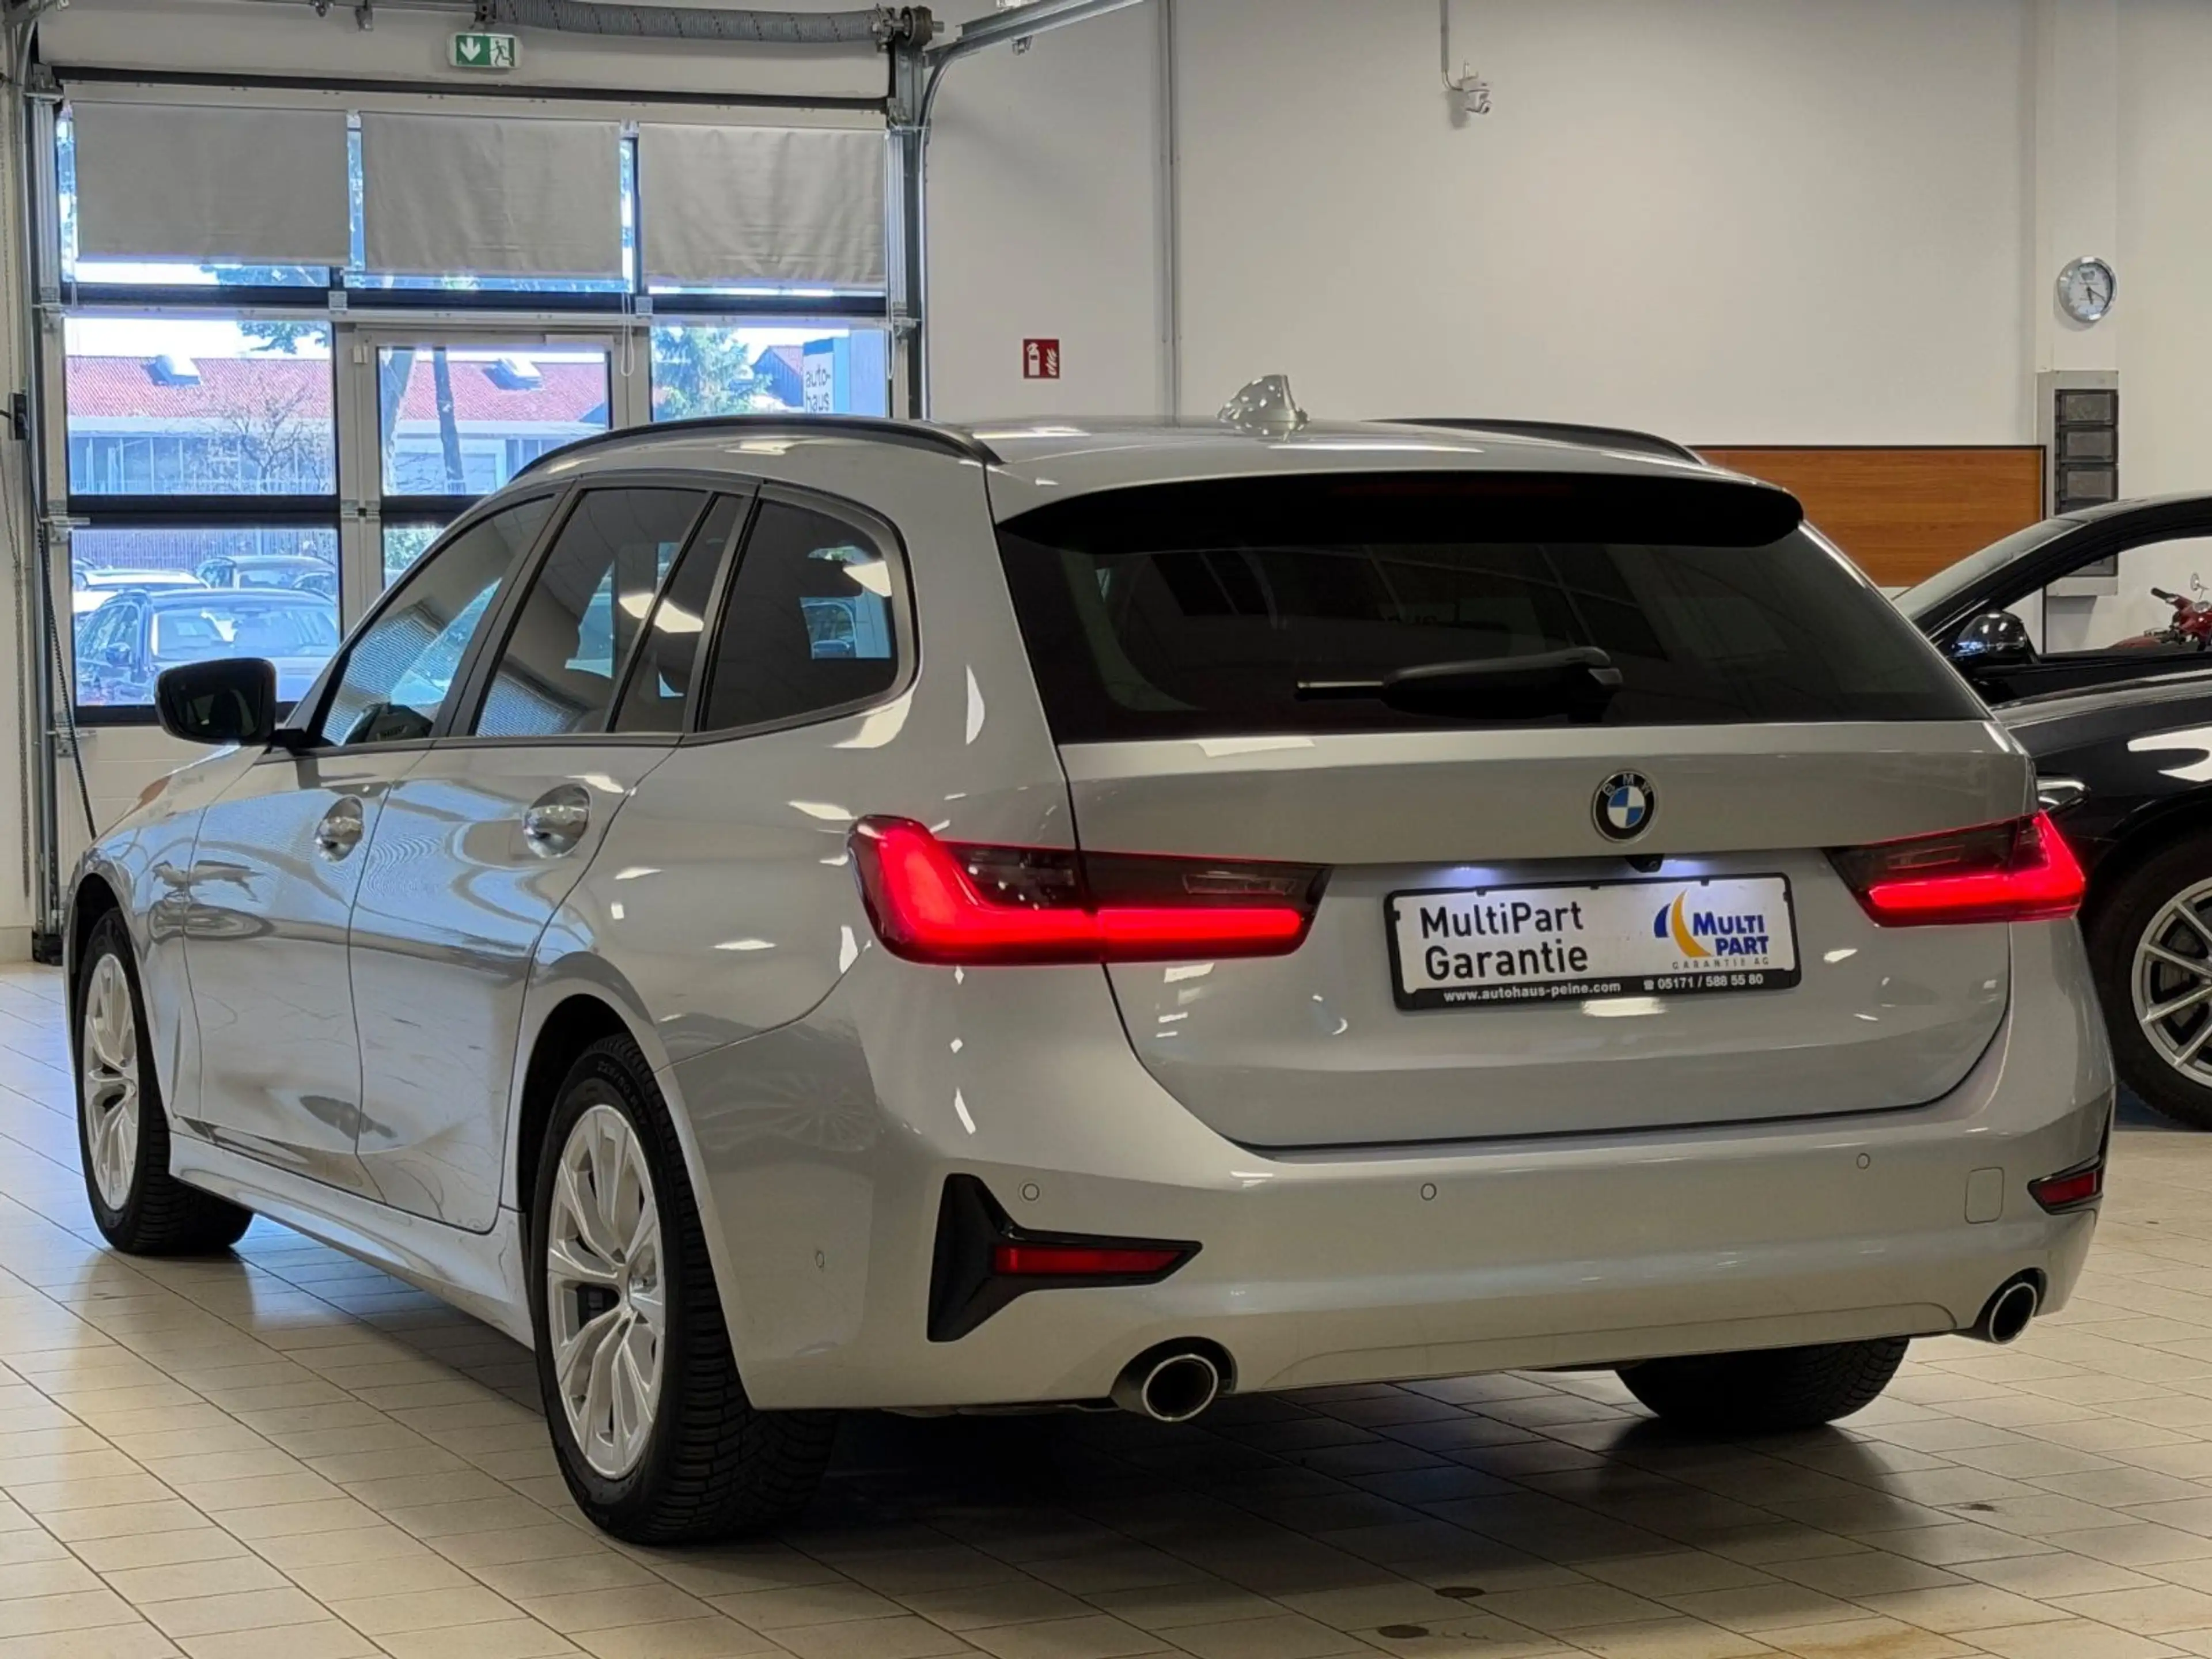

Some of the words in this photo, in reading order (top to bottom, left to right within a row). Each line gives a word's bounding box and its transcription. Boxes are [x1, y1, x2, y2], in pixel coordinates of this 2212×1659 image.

[806, 364, 831, 388] auto-
[806, 391, 830, 412] haus
[1603, 774, 1652, 796] BMW
[1420, 902, 1584, 938] MultiPart
[1692, 911, 1764, 936] MULTI
[1715, 936, 1769, 956] PART
[1425, 938, 1588, 980] Garantie
[1672, 958, 1745, 970] GARANTIE
[1754, 957, 1769, 966] AG
[1443, 982, 1622, 1002] www.autohaus-peine.com
[1657, 976, 1694, 990] 05171
[1731, 974, 1746, 986] 55
[1748, 973, 1764, 984] 80
